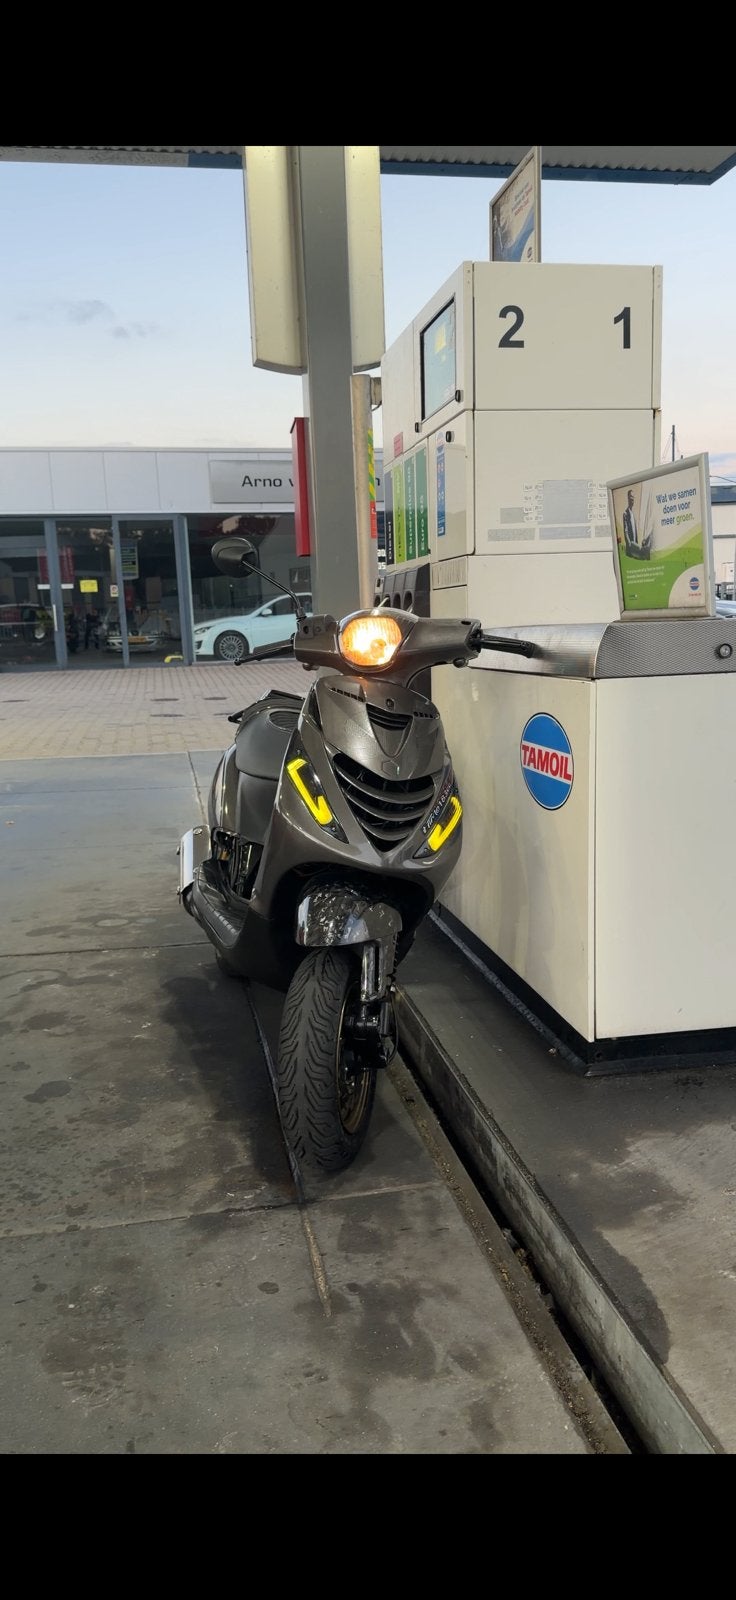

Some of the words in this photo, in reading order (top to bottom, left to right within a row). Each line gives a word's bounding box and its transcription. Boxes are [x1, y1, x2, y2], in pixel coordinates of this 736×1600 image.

[498, 305, 525, 348] 2
[613, 307, 631, 349] 1
[241, 475, 283, 488] Arno
[656, 493, 667, 504] Wat
[668, 493, 677, 501] we
[677, 488, 696, 499] samen
[663, 504, 677, 515] doen
[677, 501, 691, 511] voor
[661, 516, 675, 526] meer
[521, 744, 572, 782] TAMOIL
